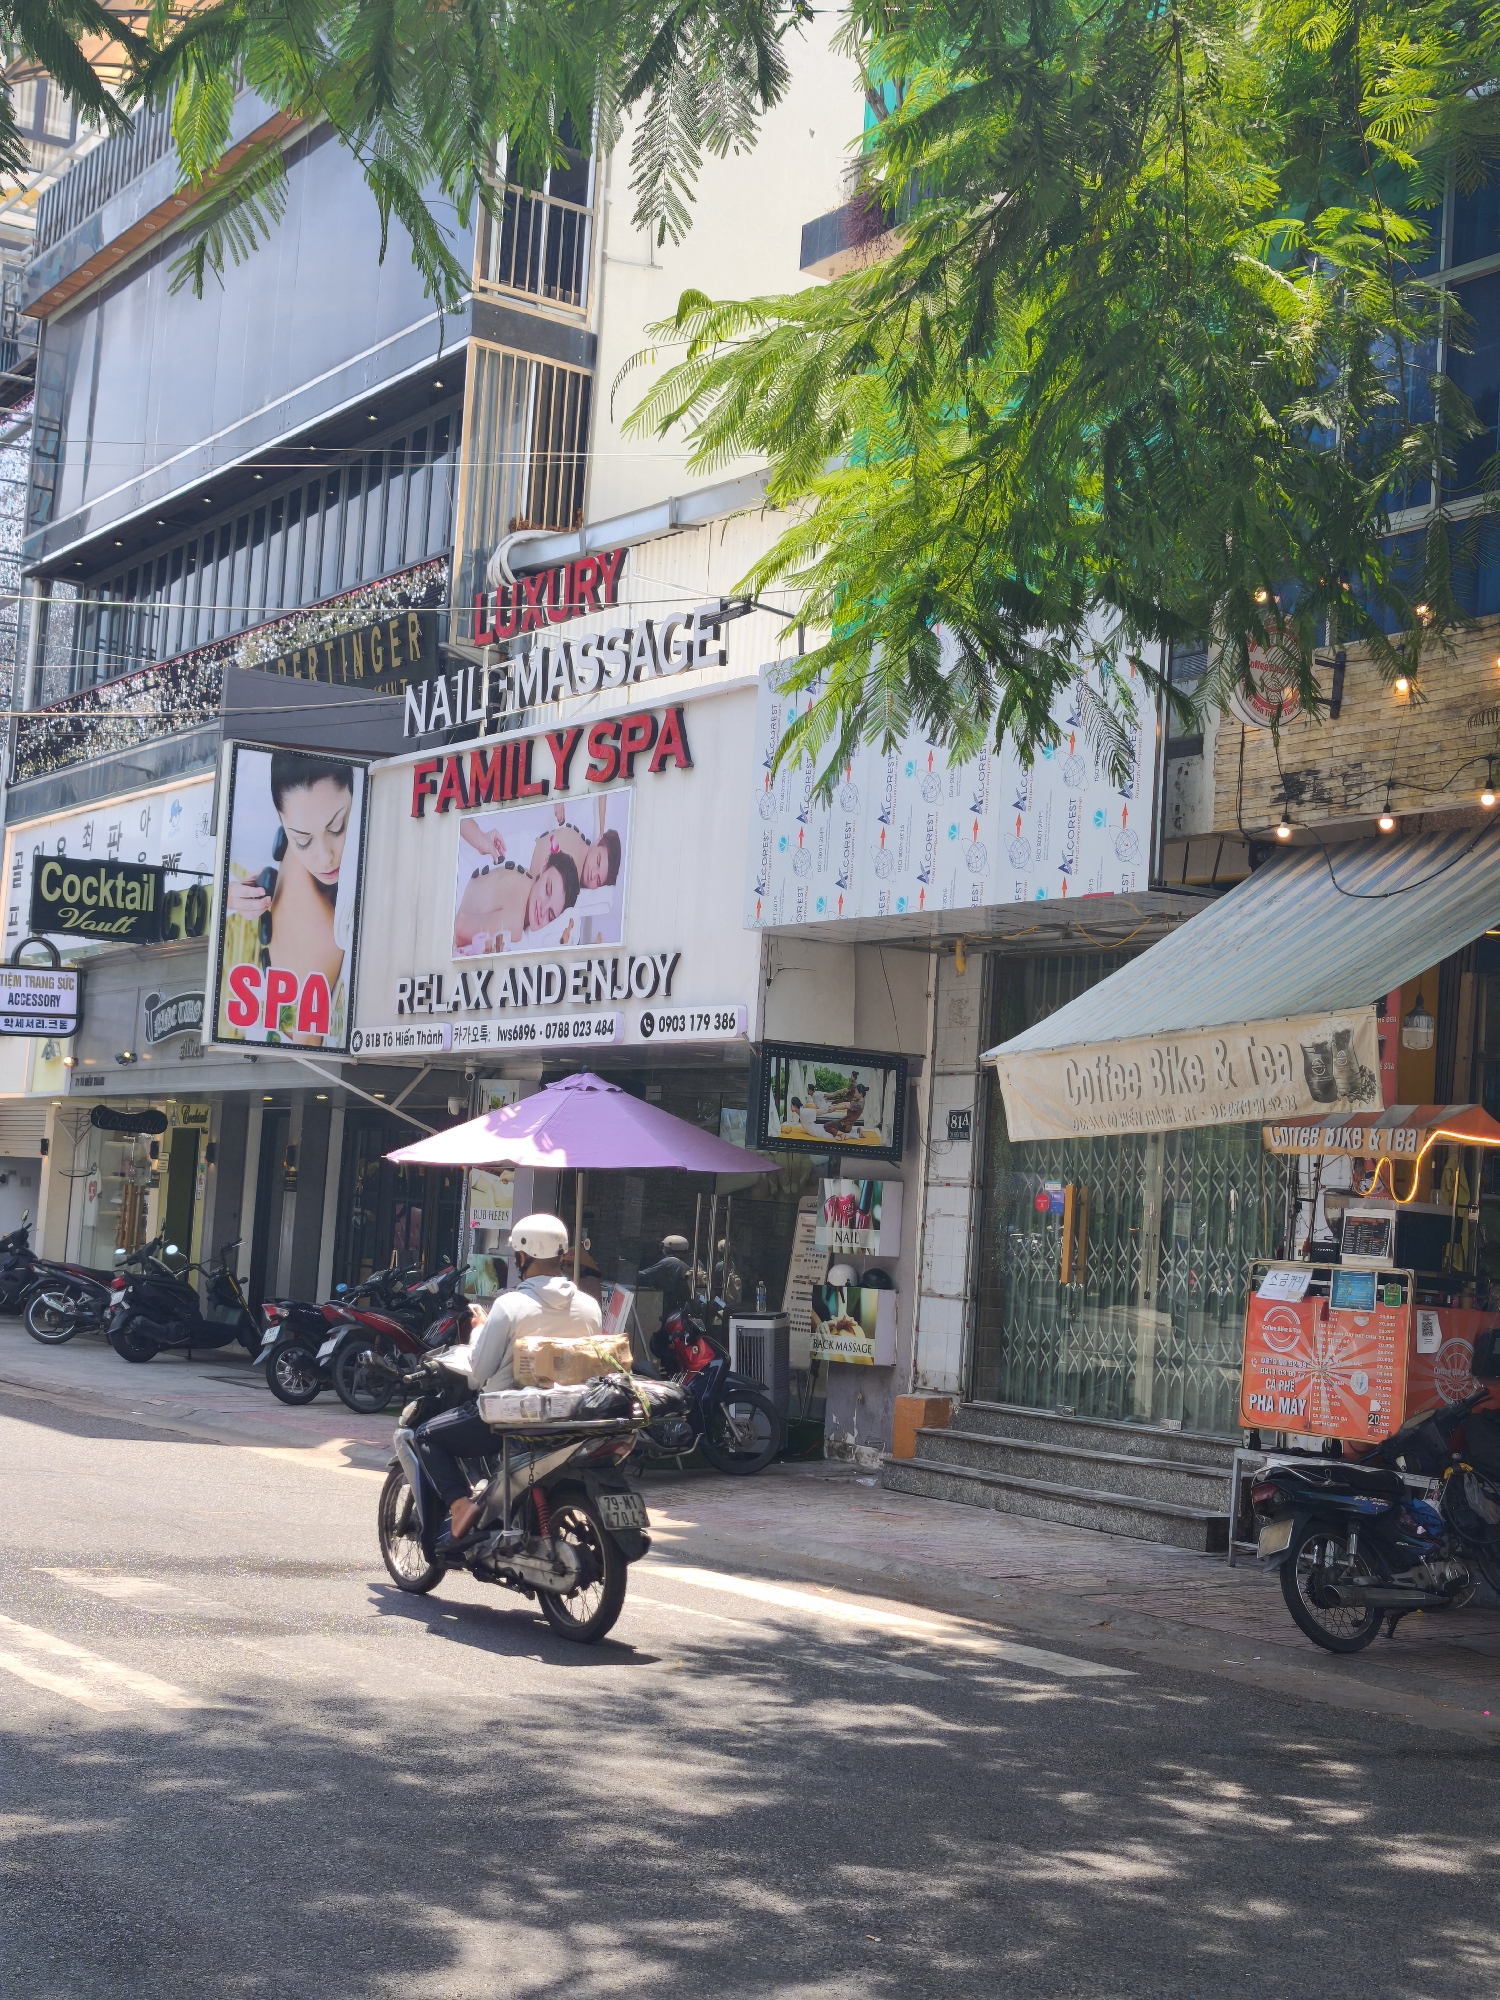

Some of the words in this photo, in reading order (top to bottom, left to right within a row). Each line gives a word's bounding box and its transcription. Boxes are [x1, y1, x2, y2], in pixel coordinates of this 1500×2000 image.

[473, 547, 629, 646] LUXURY
[263, 613, 421, 684] ERTINGER
[403, 666, 487, 737] NAIL
[513, 602, 728, 708] MASSAGE
[1249, 660, 1269, 671] offee
[411, 728, 584, 818] FAMILY
[585, 707, 694, 783] SPA
[916, 813, 935, 884] ALCOREST
[1058, 798, 1077, 875] ALCOREST
[835, 821, 852, 890] ALCOREST
[41, 861, 156, 912] Cocktail
[57, 907, 139, 934] Vault
[25, 975, 55, 990] TRANG
[57, 974, 75, 991] SỨC
[395, 969, 494, 1015] RELAX
[497, 963, 566, 1009] AND
[567, 952, 682, 1005] ENJOY
[7, 992, 62, 1008] ACCESSORY
[226, 964, 331, 1035] SPA
[545, 1021, 570, 1039] 0788
[572, 1020, 592, 1037] 023
[594, 1018, 615, 1036] 484
[658, 1014, 686, 1033] 0903
[690, 1013, 711, 1031] 179
[713, 1012, 736, 1030] 386
[365, 1033, 381, 1047] 81B
[383, 1032, 393, 1046] Tô
[396, 1027, 415, 1046] Hiến
[417, 1030, 443, 1045] Thành
[1064, 1053, 1141, 1106] Coffee
[1150, 1045, 1206, 1097] Bike
[1212, 1039, 1239, 1090] &
[1239, 1036, 1293, 1087] Tea
[950, 1113, 970, 1129] 81A
[1269, 1126, 1319, 1148] Coffee
[1323, 1127, 1362, 1150] Bike
[1368, 1127, 1381, 1151] &
[1386, 1128, 1418, 1153] Tea
[473, 1209, 487, 1220] RUB
[834, 1230, 859, 1245] NAIL
[813, 1338, 834, 1350] BACK
[835, 1342, 872, 1355] MASSAGE
[1265, 1376, 1277, 1390] CÀ
[1278, 1377, 1295, 1392] PHÊ
[1249, 1393, 1274, 1413] PHA
[1278, 1395, 1307, 1417] MÁY
[1368, 1414, 1379, 1425] 20
